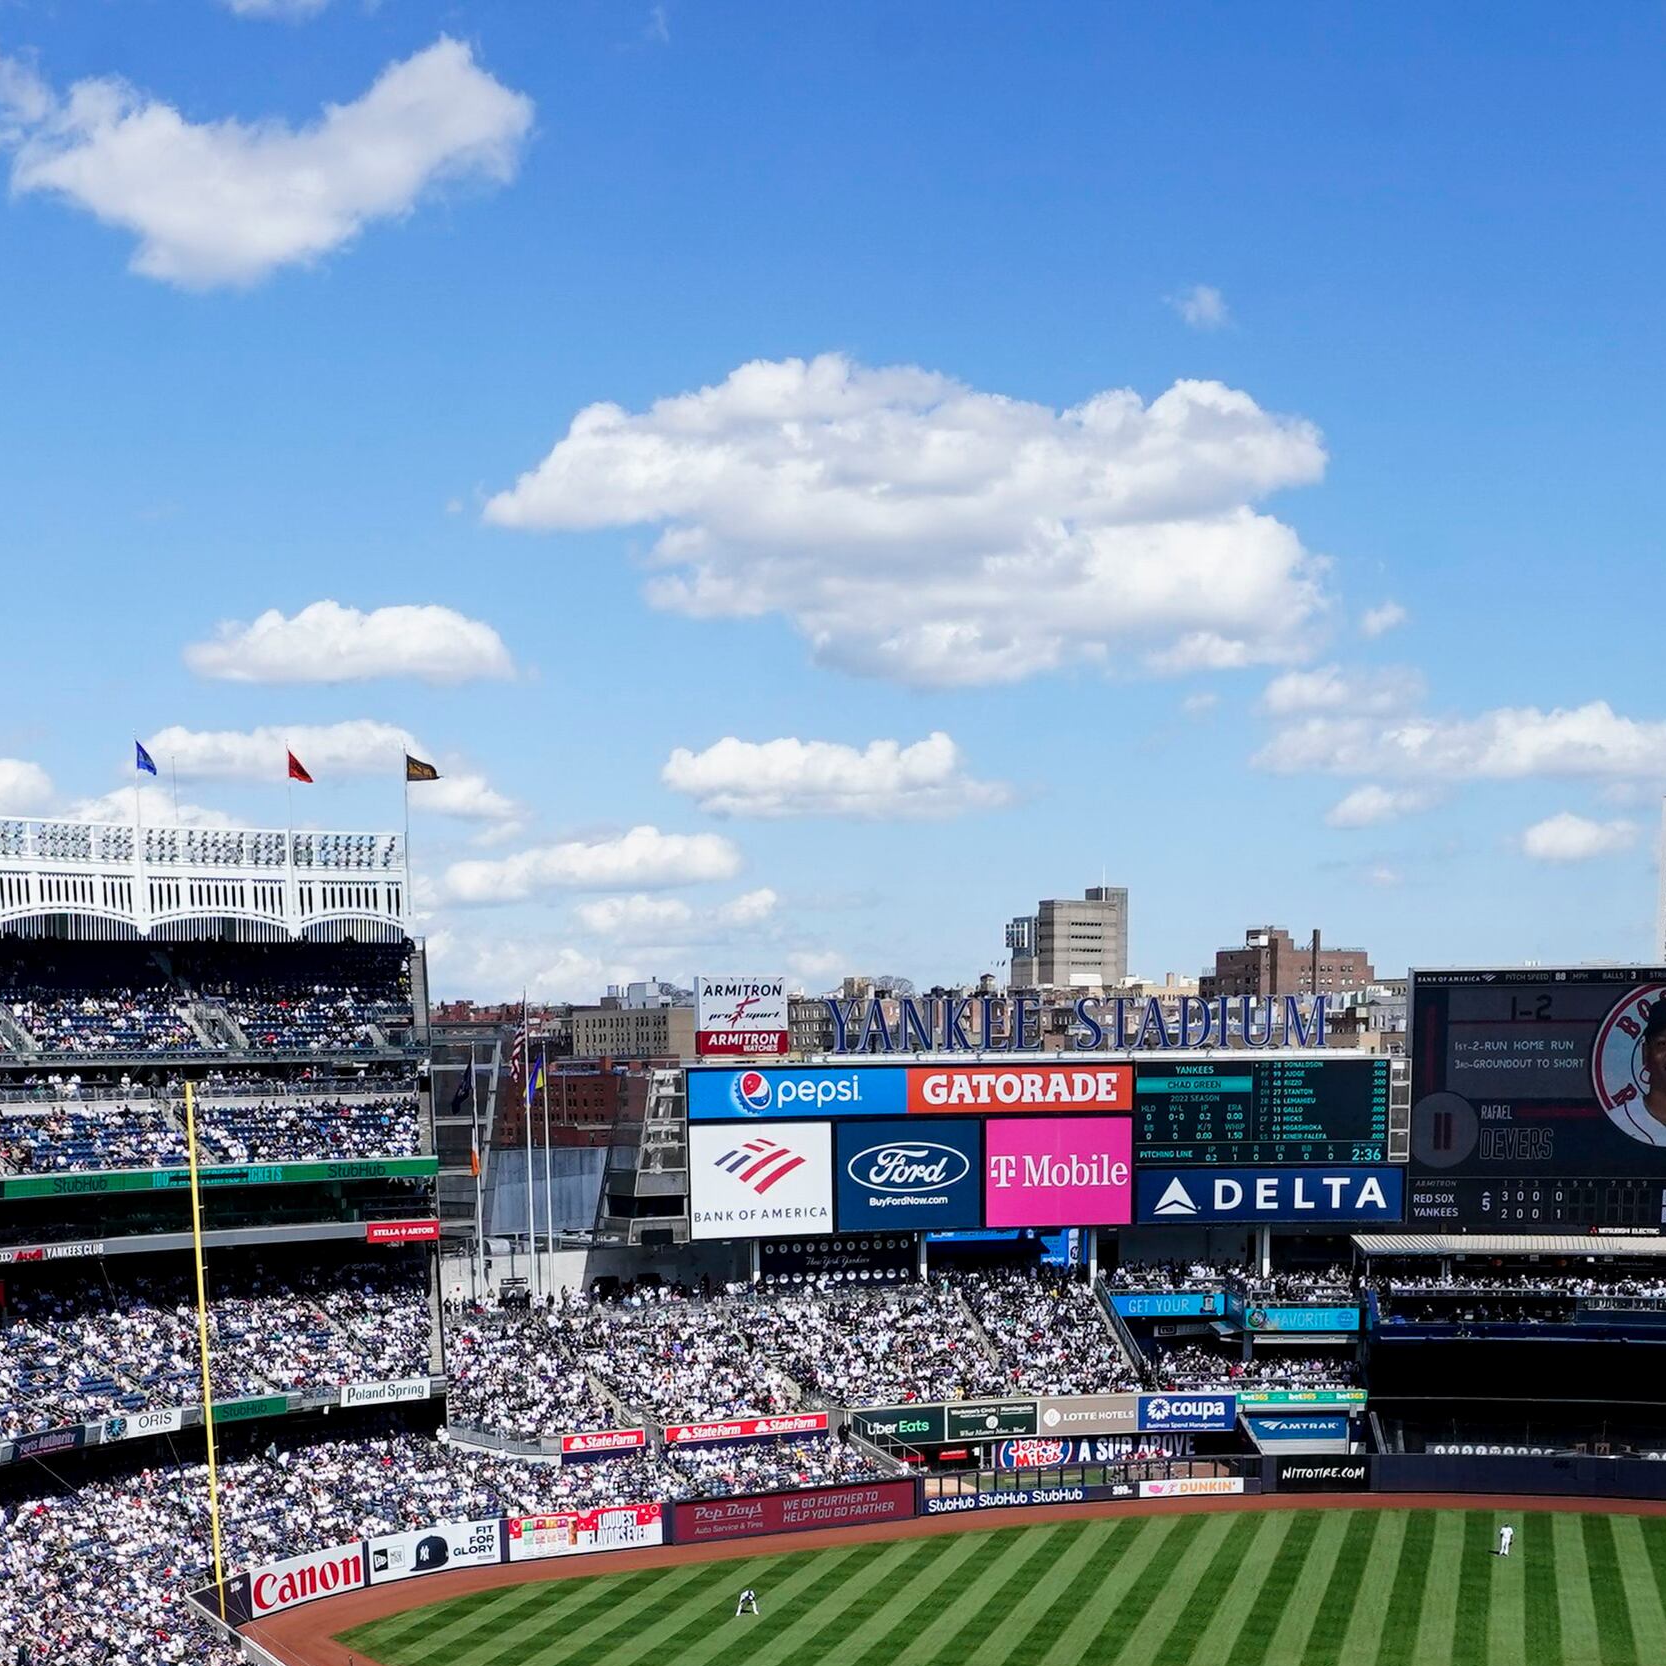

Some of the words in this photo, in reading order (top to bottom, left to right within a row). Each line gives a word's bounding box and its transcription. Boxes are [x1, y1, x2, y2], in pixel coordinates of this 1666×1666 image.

[703, 984, 782, 997] ARMITRON
[1511, 994, 1553, 1021] 1-2
[827, 997, 1043, 1054] YANKEE
[1071, 994, 1328, 1050] STADIUM
[708, 1033, 779, 1045] ARMITRON
[1513, 1040, 1544, 1050] HOME
[1550, 1040, 1574, 1050] RUN
[743, 1044, 778, 1052] WATCHES
[1175, 1066, 1214, 1074] YANKEES
[777, 1074, 860, 1108] pepsi
[922, 1072, 1119, 1105] GATORADE
[1480, 1105, 1513, 1120] RAFAEL
[1479, 1128, 1554, 1160] DEVERS
[1351, 1149, 1382, 1161] 2:36
[327, 1162, 386, 1178] StubHub
[869, 1149, 949, 1184] Ford
[990, 1156, 1016, 1188] T
[1022, 1153, 1128, 1187] Mobile
[53, 1177, 107, 1193] StubHub
[1214, 1177, 1387, 1210] DELTA
[1413, 1194, 1433, 1203] RED
[1434, 1194, 1455, 1203] SOX
[869, 1196, 949, 1208] BuyFordNow.com
[694, 1211, 734, 1223] BANK
[738, 1209, 757, 1221] OF
[761, 1207, 828, 1220] AMERICA
[1413, 1208, 1459, 1217] YANKEES
[373, 1226, 400, 1236] STELLA
[406, 1225, 435, 1236] ARTOIS
[46, 1244, 82, 1259] YANKEES
[83, 1243, 105, 1255] CLUB
[1128, 1300, 1150, 1313] GET
[1156, 1298, 1190, 1312] YOUR
[1275, 1313, 1331, 1327] FAVORITE
[346, 1388, 386, 1404] Poland
[387, 1382, 425, 1401] Spring
[1240, 1393, 1269, 1401] bet365
[1288, 1393, 1317, 1401] bet365
[1336, 1392, 1365, 1400] bet365
[222, 1402, 268, 1418] StubHub
[1063, 1411, 1096, 1421] LOTTE
[1098, 1410, 1134, 1420] HOTELS
[1171, 1402, 1226, 1420] coupa
[138, 1412, 172, 1428] ORIS
[867, 1421, 897, 1436] Uber
[898, 1419, 930, 1433] Eats
[1279, 1421, 1339, 1431] AMTRAK
[1282, 1466, 1365, 1480] NITTOTIRE.COM
[1180, 1481, 1237, 1493] DUNKIN'
[783, 1500, 800, 1511] WE
[801, 1498, 817, 1509] GO
[818, 1493, 863, 1508] FURTHER
[865, 1491, 879, 1502] TO
[978, 1490, 1028, 1507] StubHub
[1032, 1487, 1083, 1504] StubHub
[694, 1506, 725, 1521] Pep
[726, 1502, 764, 1518] Boys
[783, 1510, 808, 1523] HELP
[809, 1508, 832, 1521] YOU
[833, 1507, 848, 1518] GO
[849, 1501, 895, 1516] FARTHER
[928, 1497, 975, 1513] StubHub
[597, 1511, 638, 1530] LOUDEST
[476, 1525, 494, 1535] FIT
[469, 1535, 494, 1546] FOR
[452, 1543, 494, 1558] GLORY
[252, 1554, 362, 1612] Canon
